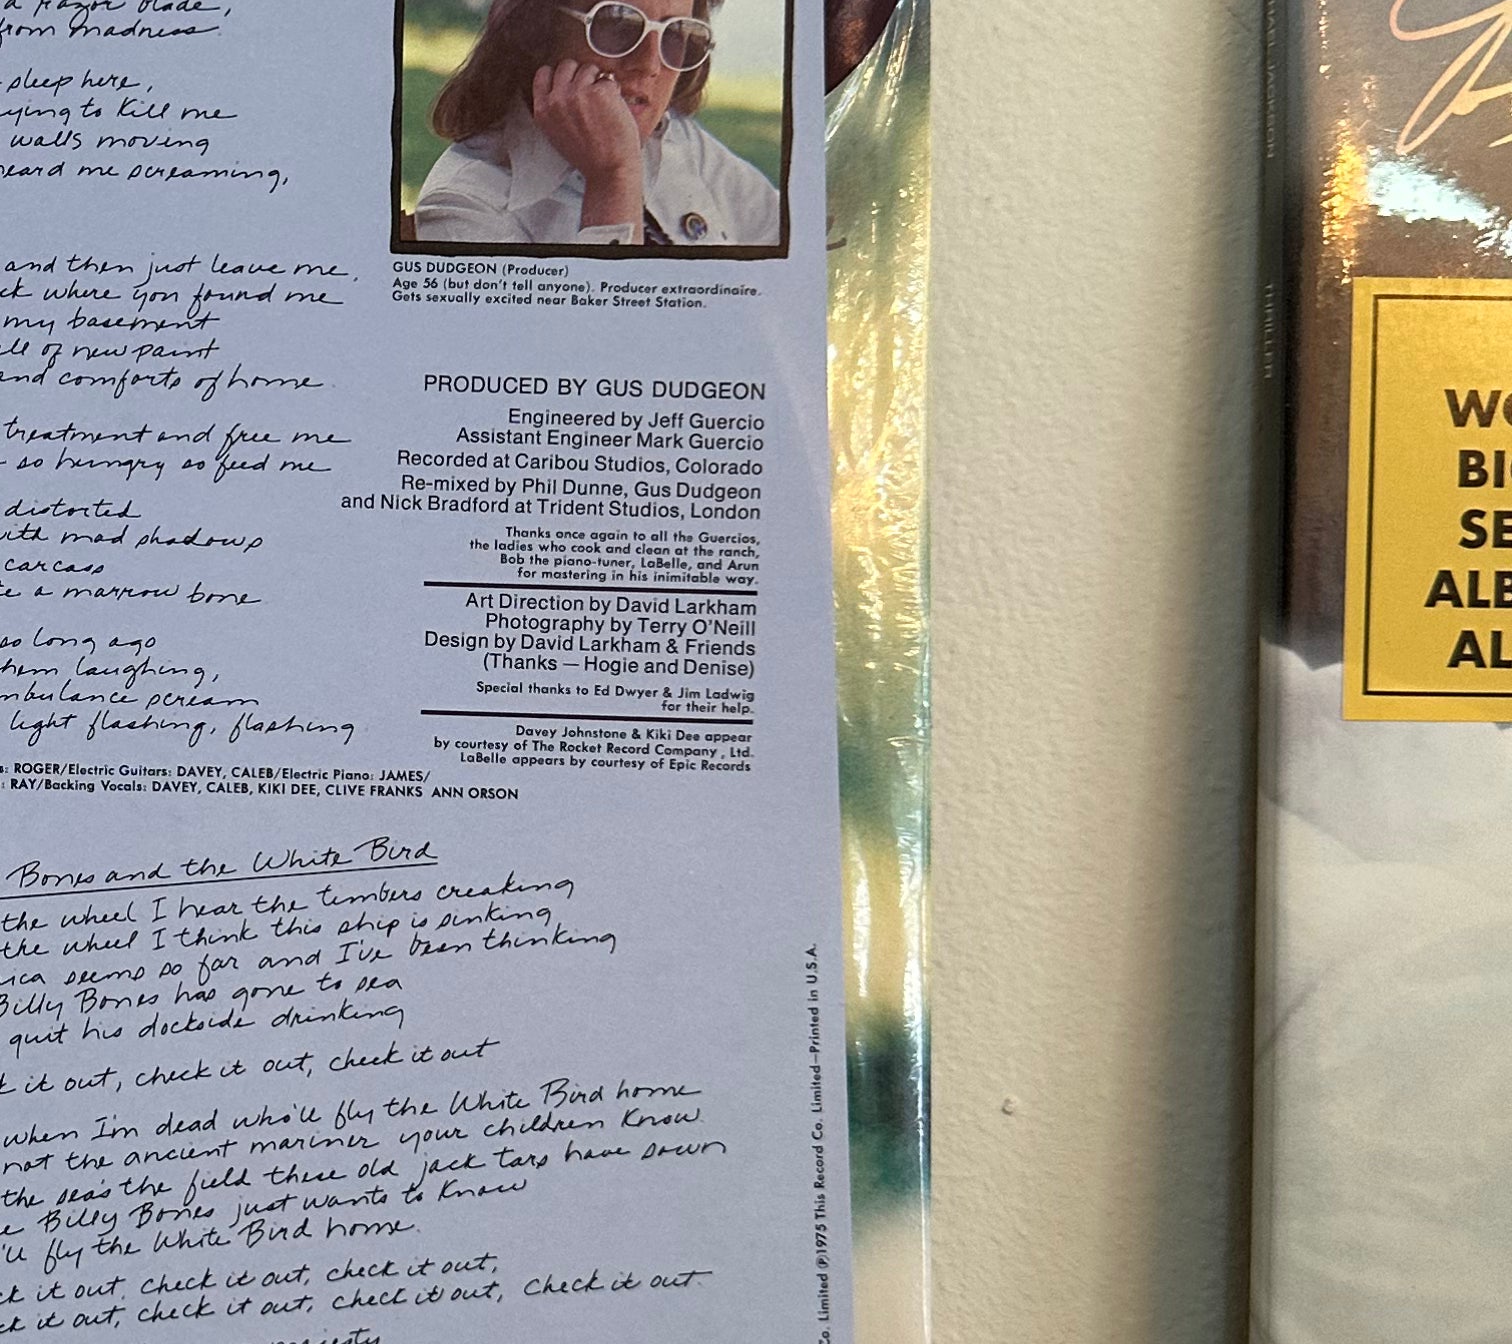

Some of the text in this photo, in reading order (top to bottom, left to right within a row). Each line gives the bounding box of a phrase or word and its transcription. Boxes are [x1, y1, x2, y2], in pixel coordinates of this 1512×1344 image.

[392, 261, 569, 277] GUS DUDGEON (Producer)
[392, 277, 763, 297] Age 56 (but don't tell anyone). Producer extraordinaire.
[392, 292, 708, 308] Gets sexually excited near Baker Street Station.
[424, 374, 765, 400] PRODUCED BY GUS DUDGEON
[508, 407, 765, 431] Engineered by Jeff Guercio
[1443, 388, 1512, 428] W
[456, 426, 764, 451] Assistant Engineer Mark Guercio
[397, 449, 763, 476] Recorded at Caribou Studios, Colorado
[1457, 449, 1512, 488] BI
[401, 474, 761, 503] Re-mixed by Phil Dunne, Gus Dudgeon
[341, 493, 760, 521] and Nick Bradford at Trident Studios, London
[465, 592, 757, 616] Art Direction by David Larkham
[485, 612, 756, 639] Photography by Terry O'Neill
[424, 630, 756, 656] Design by David Larkham & Friends
[1446, 630, 1512, 669] AL
[483, 652, 558, 672] (Thanks
[584, 655, 639, 676] Hogie
[643, 658, 679, 675] and
[683, 658, 755, 680] Denise)
[7, 861, 94, 890] Bones
[105, 866, 173, 884] and
[181, 858, 237, 877] the
[253, 849, 353, 873] White
[354, 839, 438, 861] Bird
[816, 1273, 830, 1322] Limited
